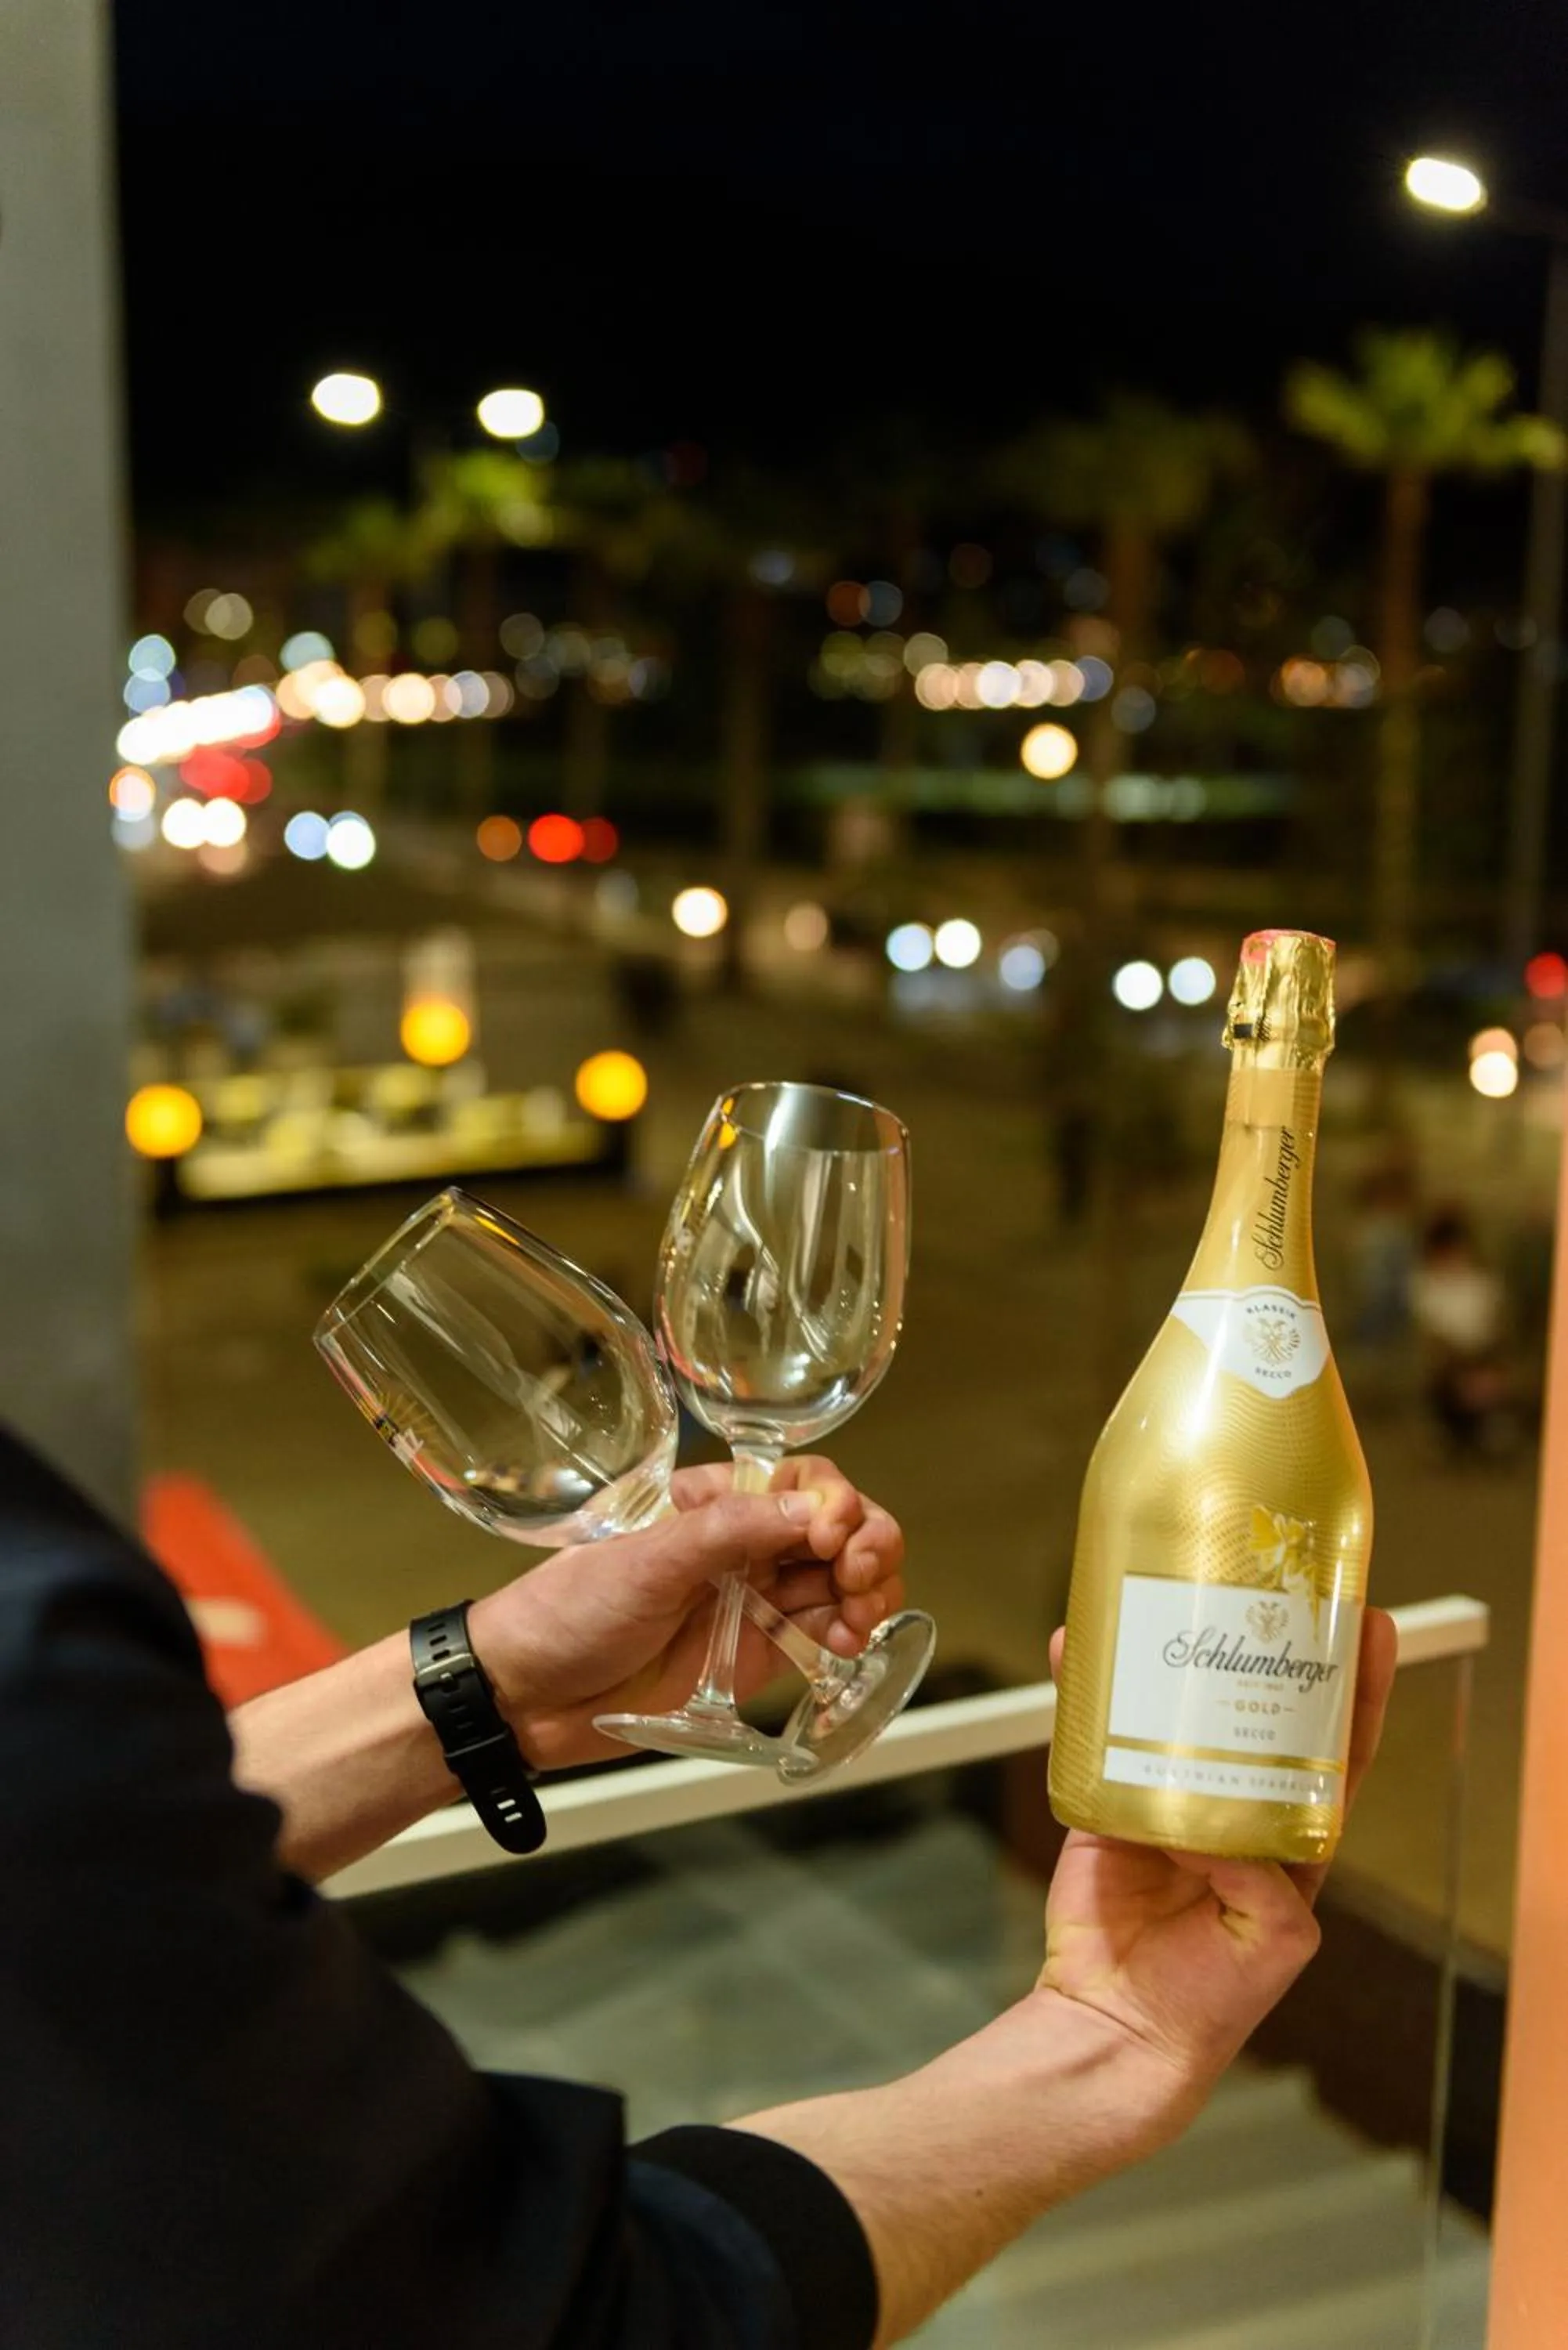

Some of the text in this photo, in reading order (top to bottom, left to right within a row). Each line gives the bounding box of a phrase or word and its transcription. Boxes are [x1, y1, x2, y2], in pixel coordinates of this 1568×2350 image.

[1252, 1126, 1301, 1271] Schlumberger
[1246, 1303, 1296, 1320] KLASSIK
[1162, 1625, 1339, 1694] Schlumberger
[1234, 1698, 1281, 1716] GOLD
